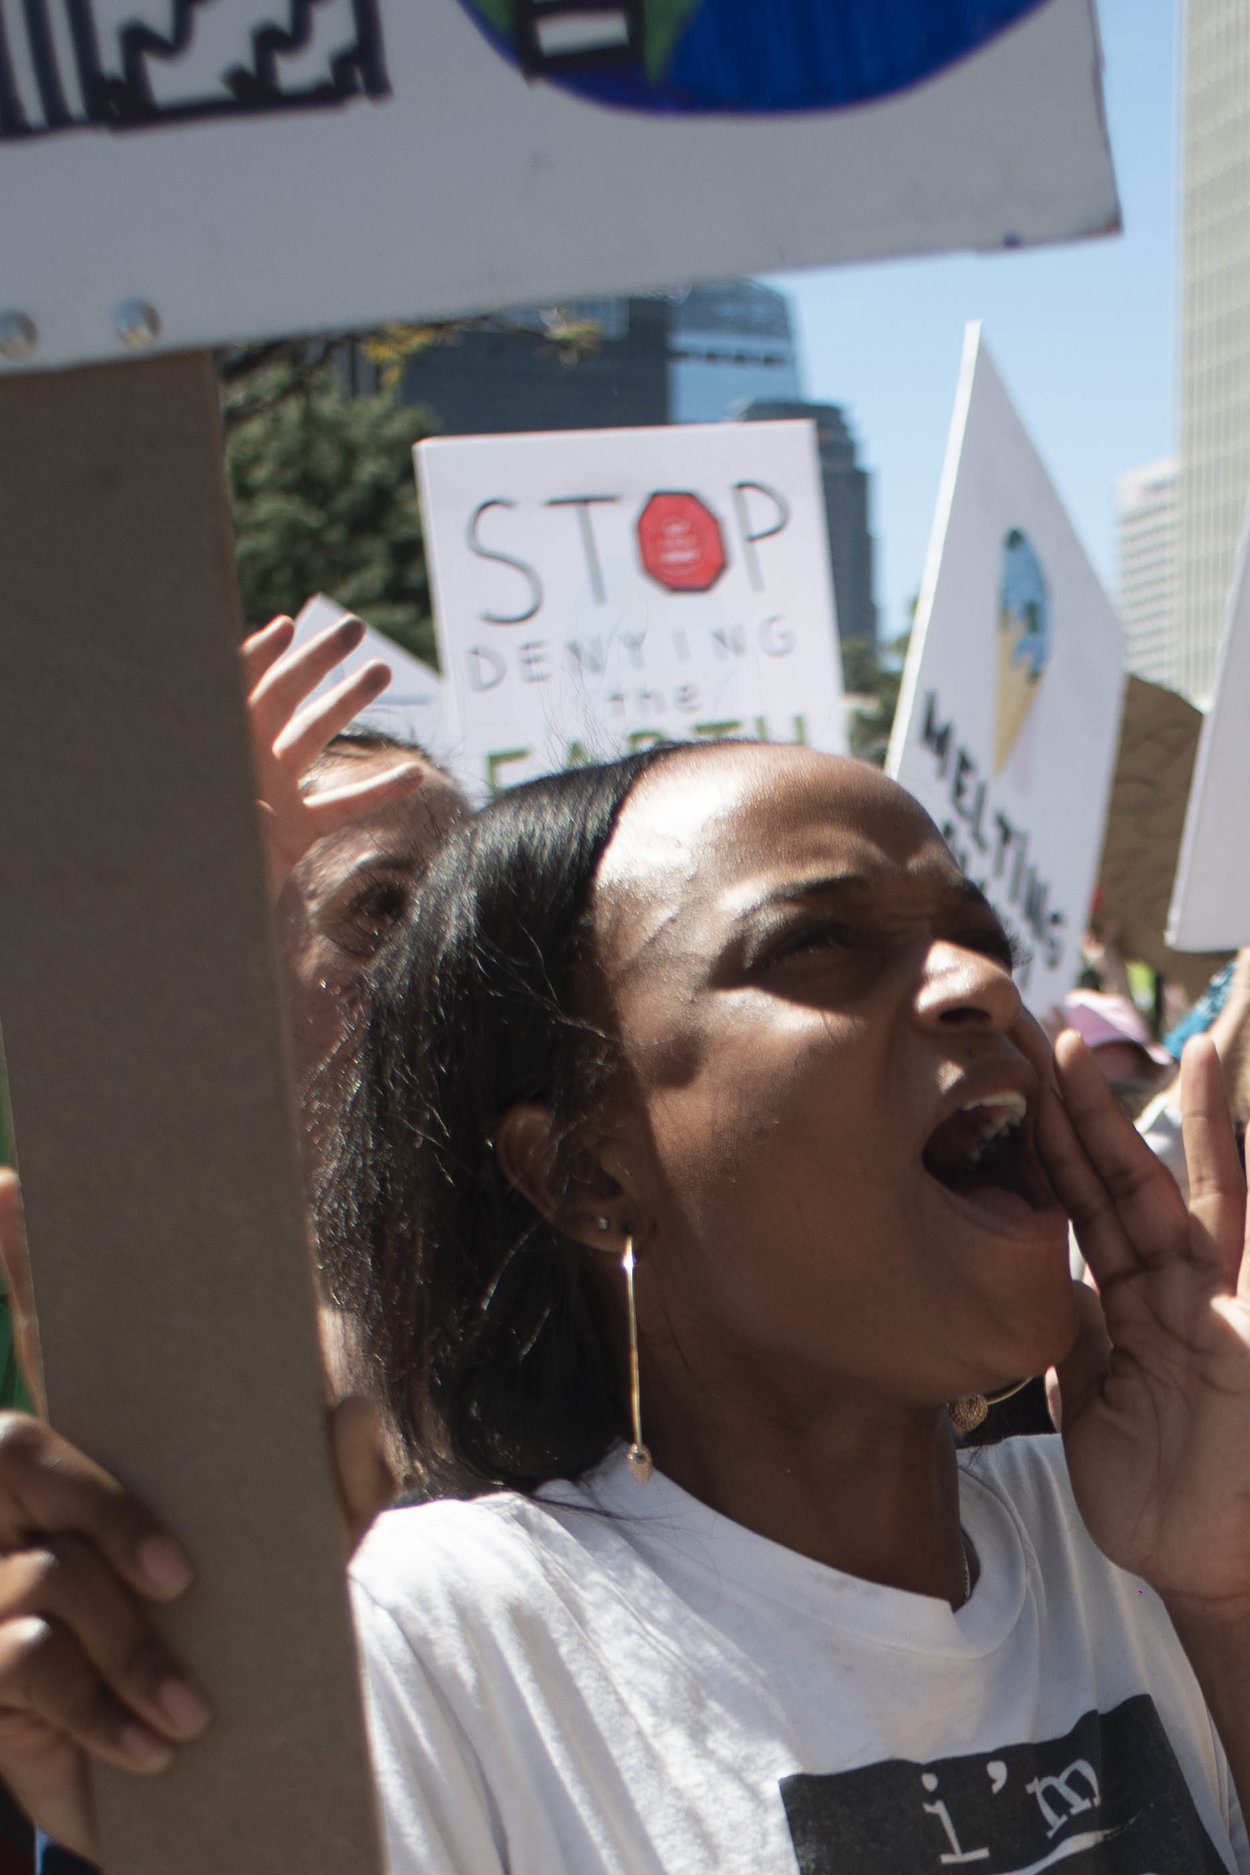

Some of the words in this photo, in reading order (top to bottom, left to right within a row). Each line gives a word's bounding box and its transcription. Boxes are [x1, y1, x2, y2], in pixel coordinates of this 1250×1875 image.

[467, 479, 790, 625] STOP
[465, 615, 798, 693] DENYING
[607, 685, 702, 715] the
[920, 686, 1063, 974] MELTING
[921, 1758, 1101, 1866] i'm
